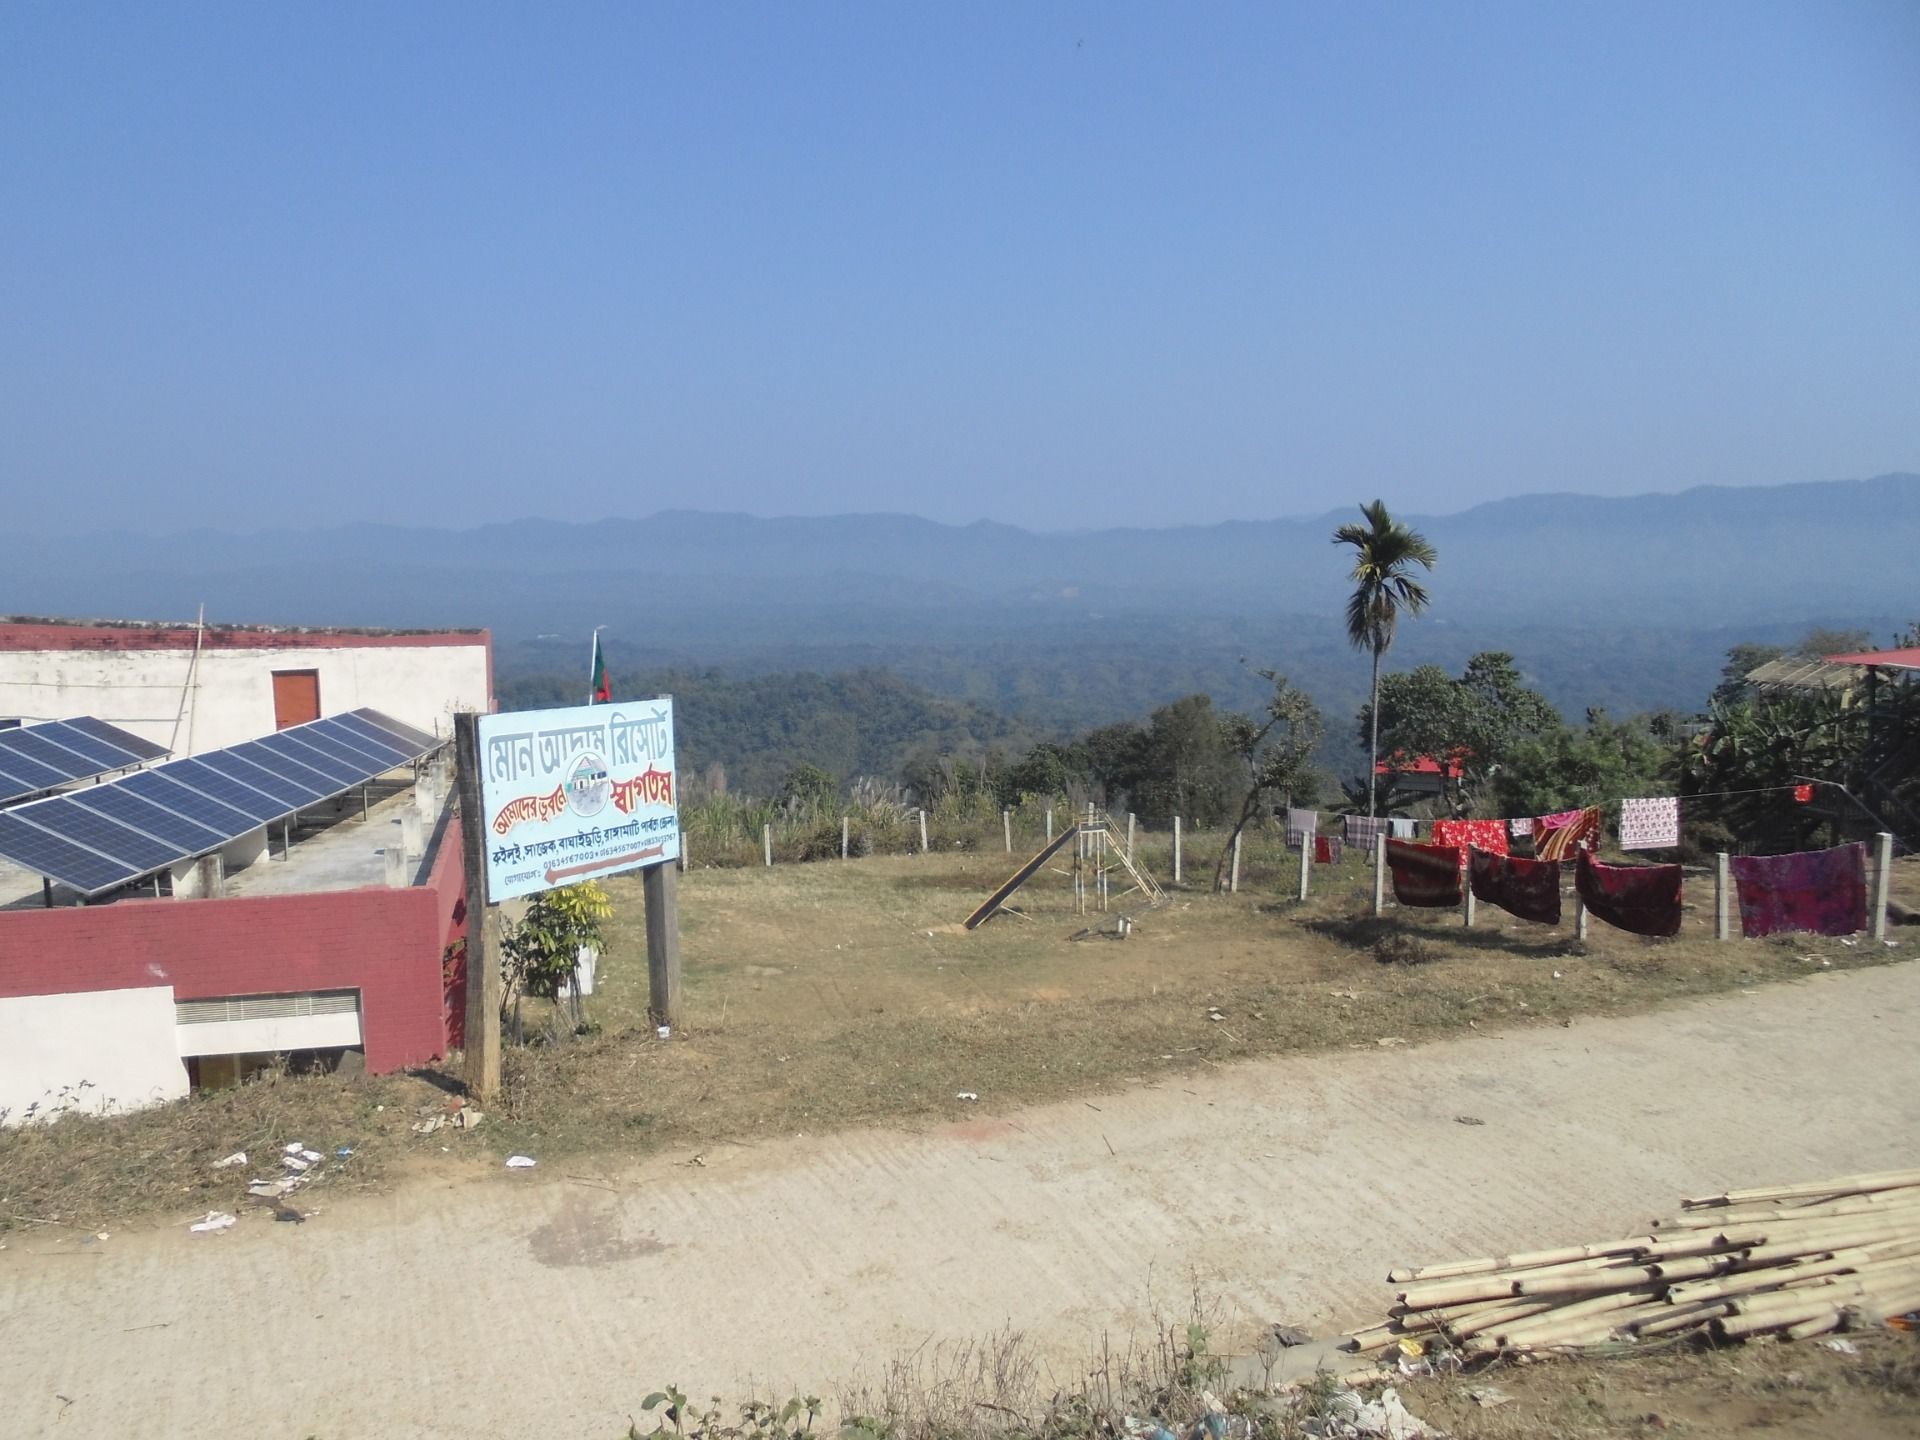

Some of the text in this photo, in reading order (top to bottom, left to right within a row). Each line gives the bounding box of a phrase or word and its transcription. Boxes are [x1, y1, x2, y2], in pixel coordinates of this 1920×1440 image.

[488, 707, 669, 783] মোন আদাম রিসোর্ট
[493, 796, 538, 835] আমাদের
